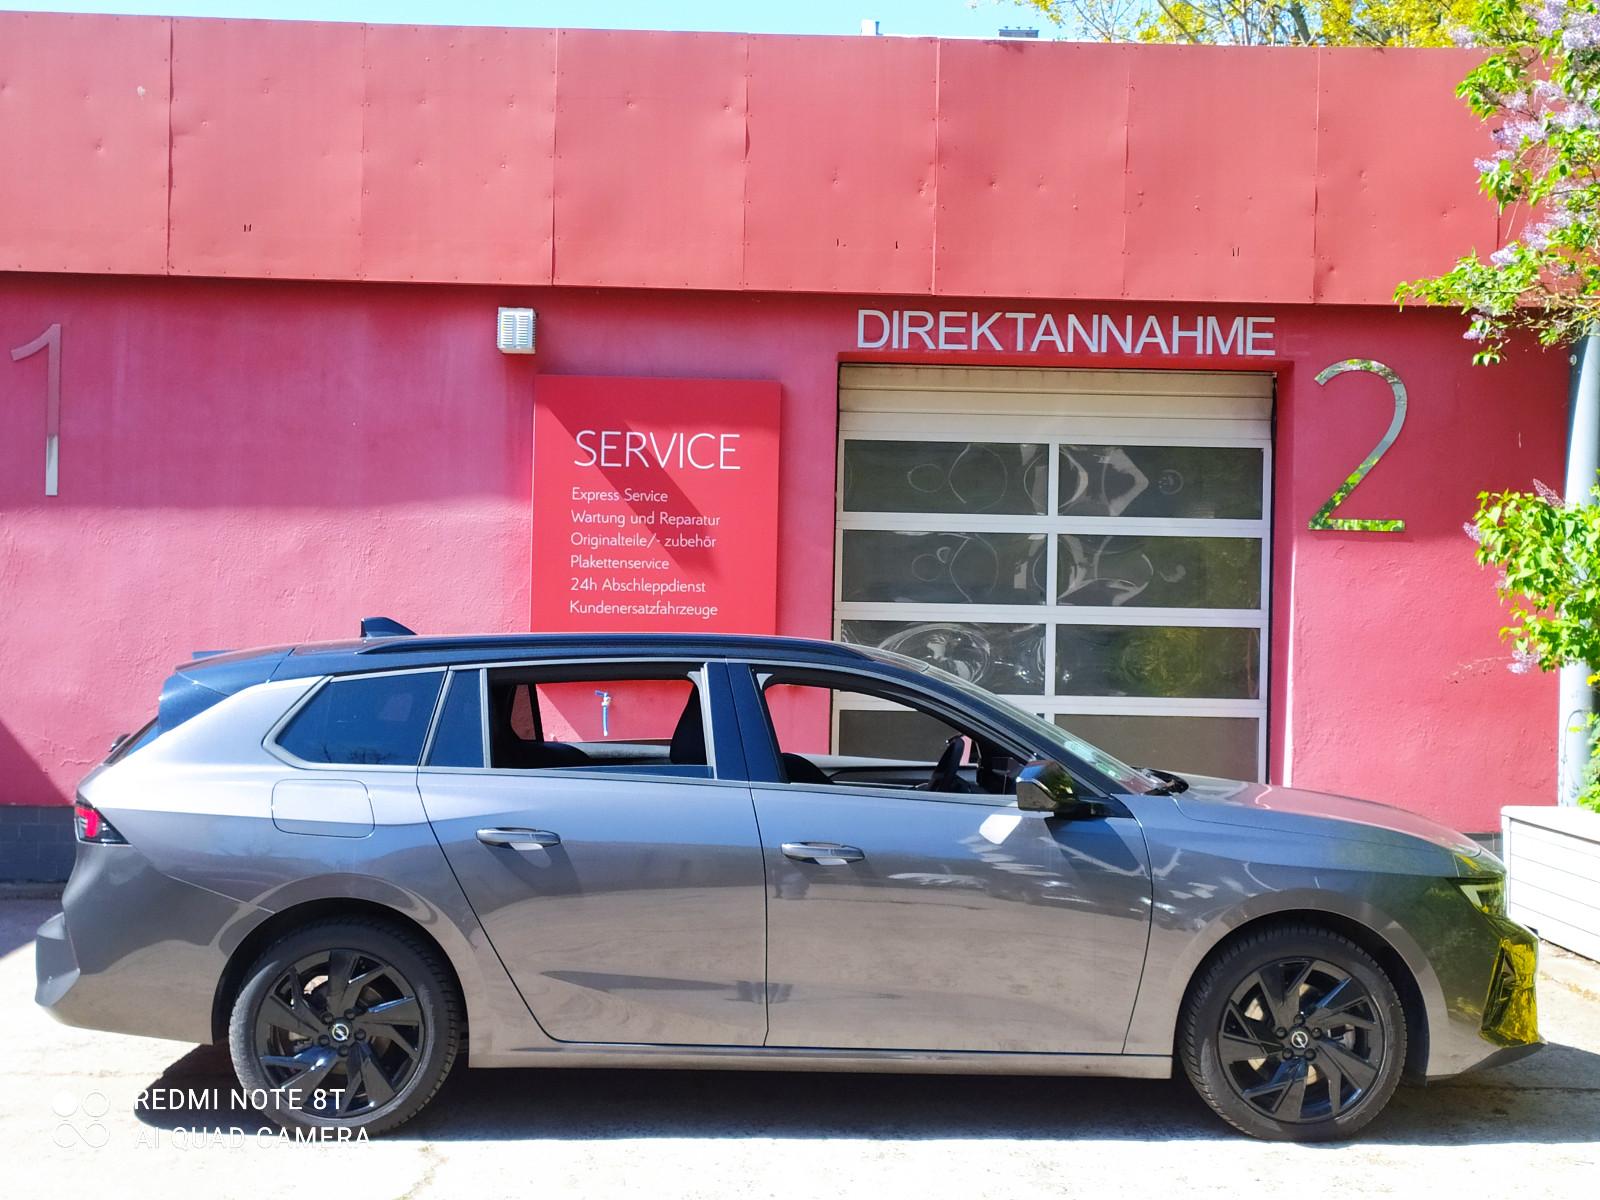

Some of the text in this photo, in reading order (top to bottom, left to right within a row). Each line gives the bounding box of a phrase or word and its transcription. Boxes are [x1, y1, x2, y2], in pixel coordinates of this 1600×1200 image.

[856, 309, 1277, 356] DIREKTANNAHME
[10, 323, 62, 496] 1
[574, 430, 741, 470] SERVICE
[1308, 358, 1408, 532] 2
[572, 487, 669, 504] Express Service
[570, 510, 721, 528] Wartung und Reparatur
[664, 534, 717, 548] zubehör
[570, 554, 670, 570] Plakettenservice
[570, 577, 706, 595] 24h Abschleppdienst
[569, 600, 719, 619] Kundenersatzfahrzeuge
